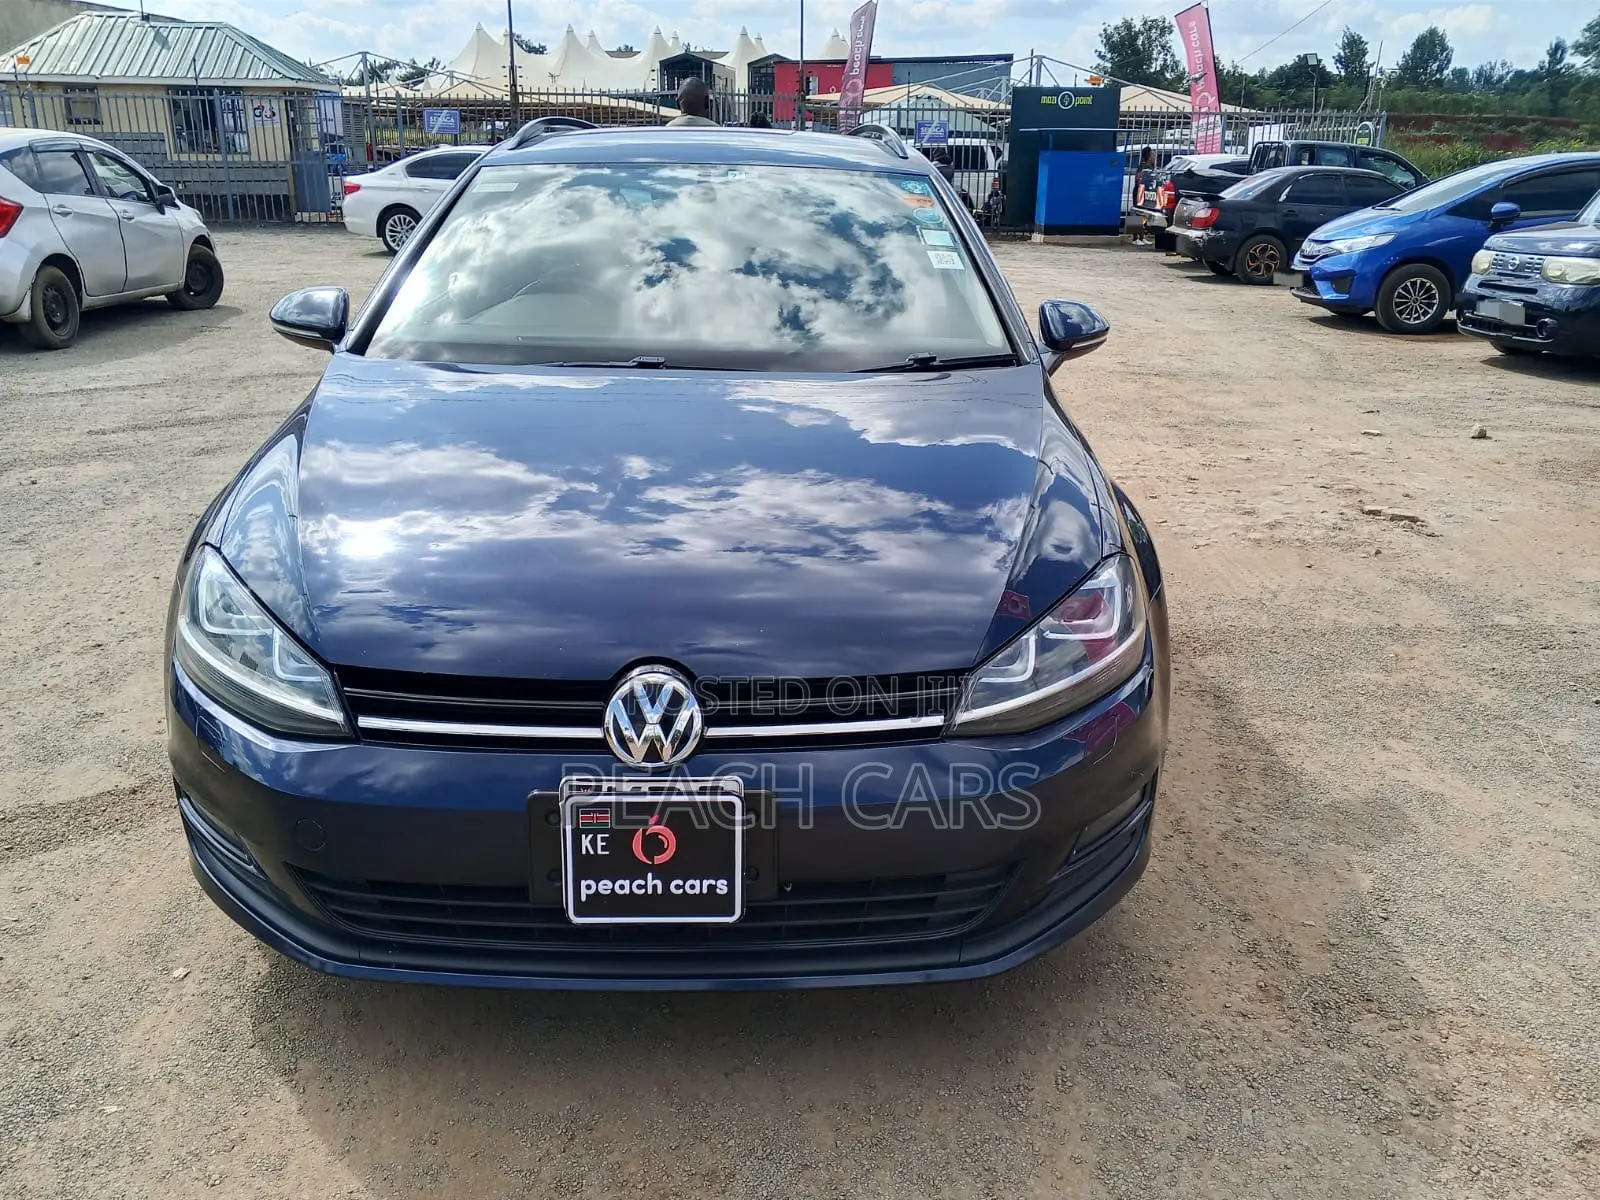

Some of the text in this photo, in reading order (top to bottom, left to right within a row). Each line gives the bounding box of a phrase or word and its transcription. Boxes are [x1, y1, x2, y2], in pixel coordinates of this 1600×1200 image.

[581, 834, 610, 855] KE
[580, 872, 729, 902] peach cars
